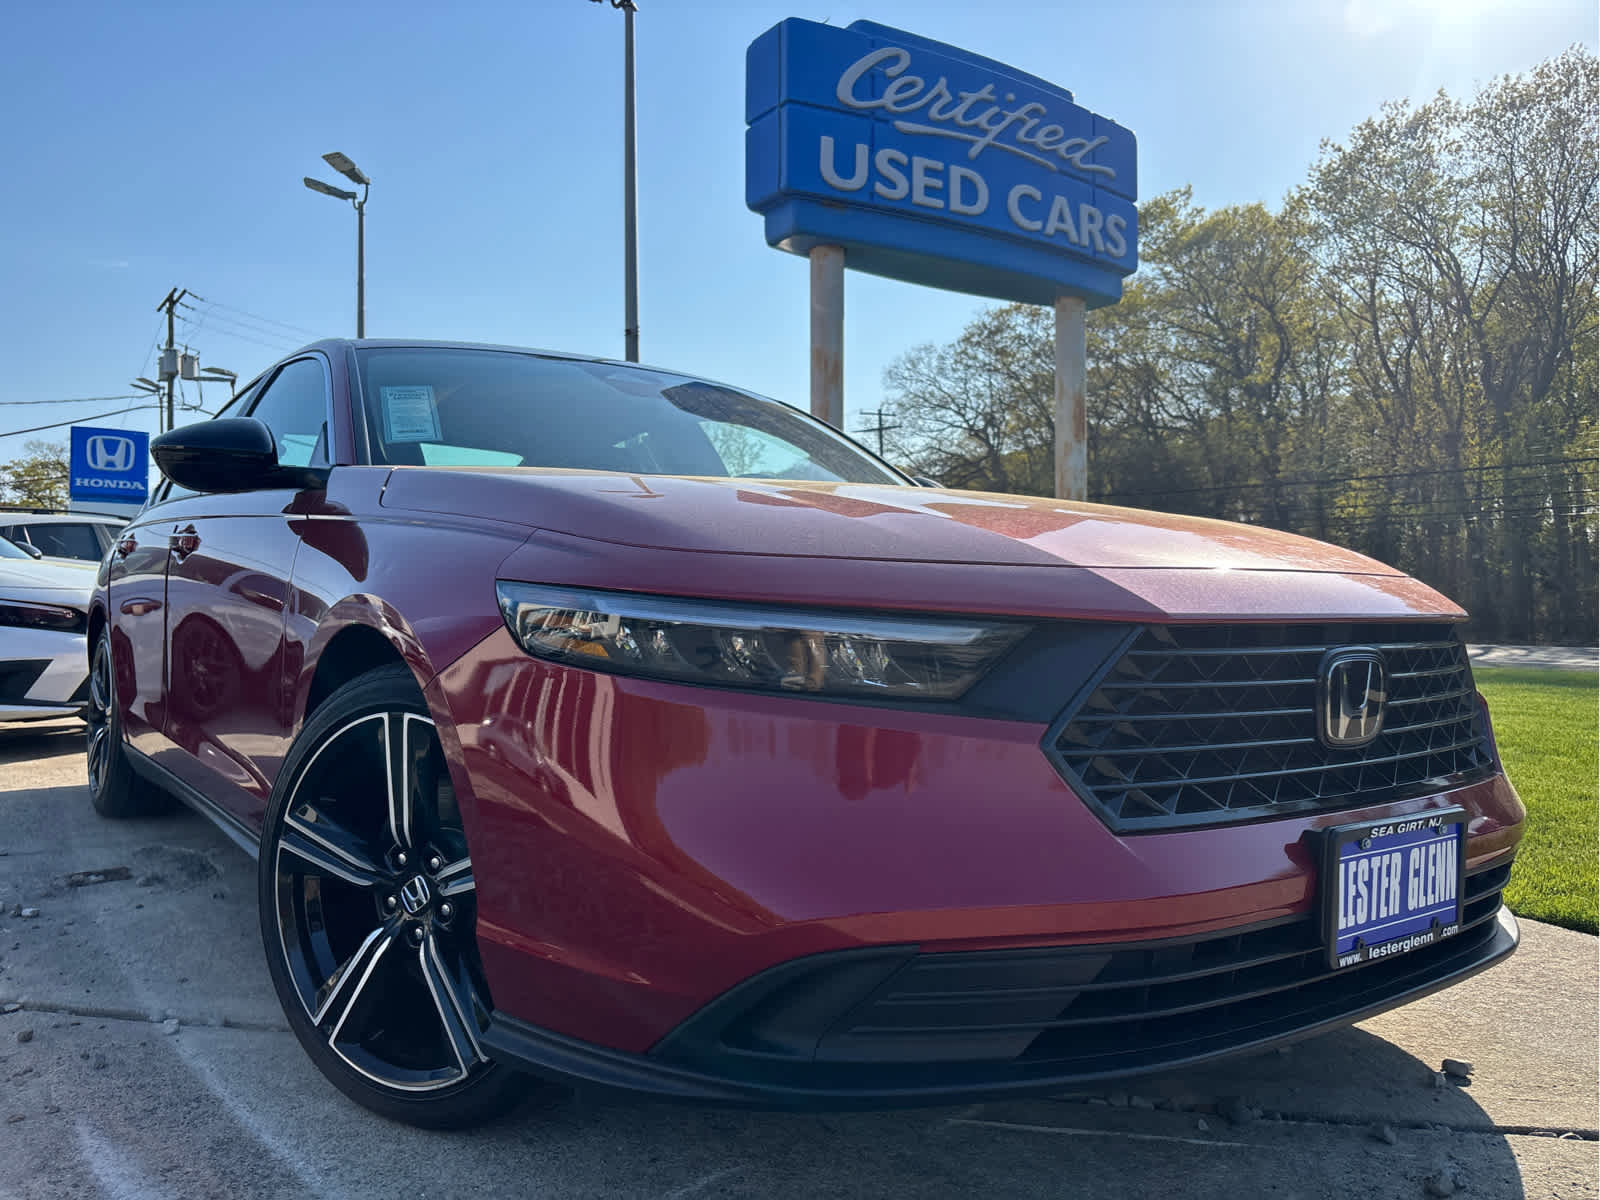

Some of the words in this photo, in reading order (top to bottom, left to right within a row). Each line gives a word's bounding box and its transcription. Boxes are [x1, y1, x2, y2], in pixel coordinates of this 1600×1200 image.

[836, 47, 1116, 180] Certified
[819, 135, 990, 217] USED
[1007, 184, 1128, 259] CARS
[75, 478, 145, 491] HONDA
[1370, 826, 1394, 838] SEA
[1428, 817, 1443, 828] NJ
[1338, 852, 1402, 931] LESTER
[1407, 839, 1457, 911] GLENN
[1339, 953, 1363, 967] www.
[1368, 932, 1434, 960] lesterglenn
[1441, 925, 1459, 937] .com
